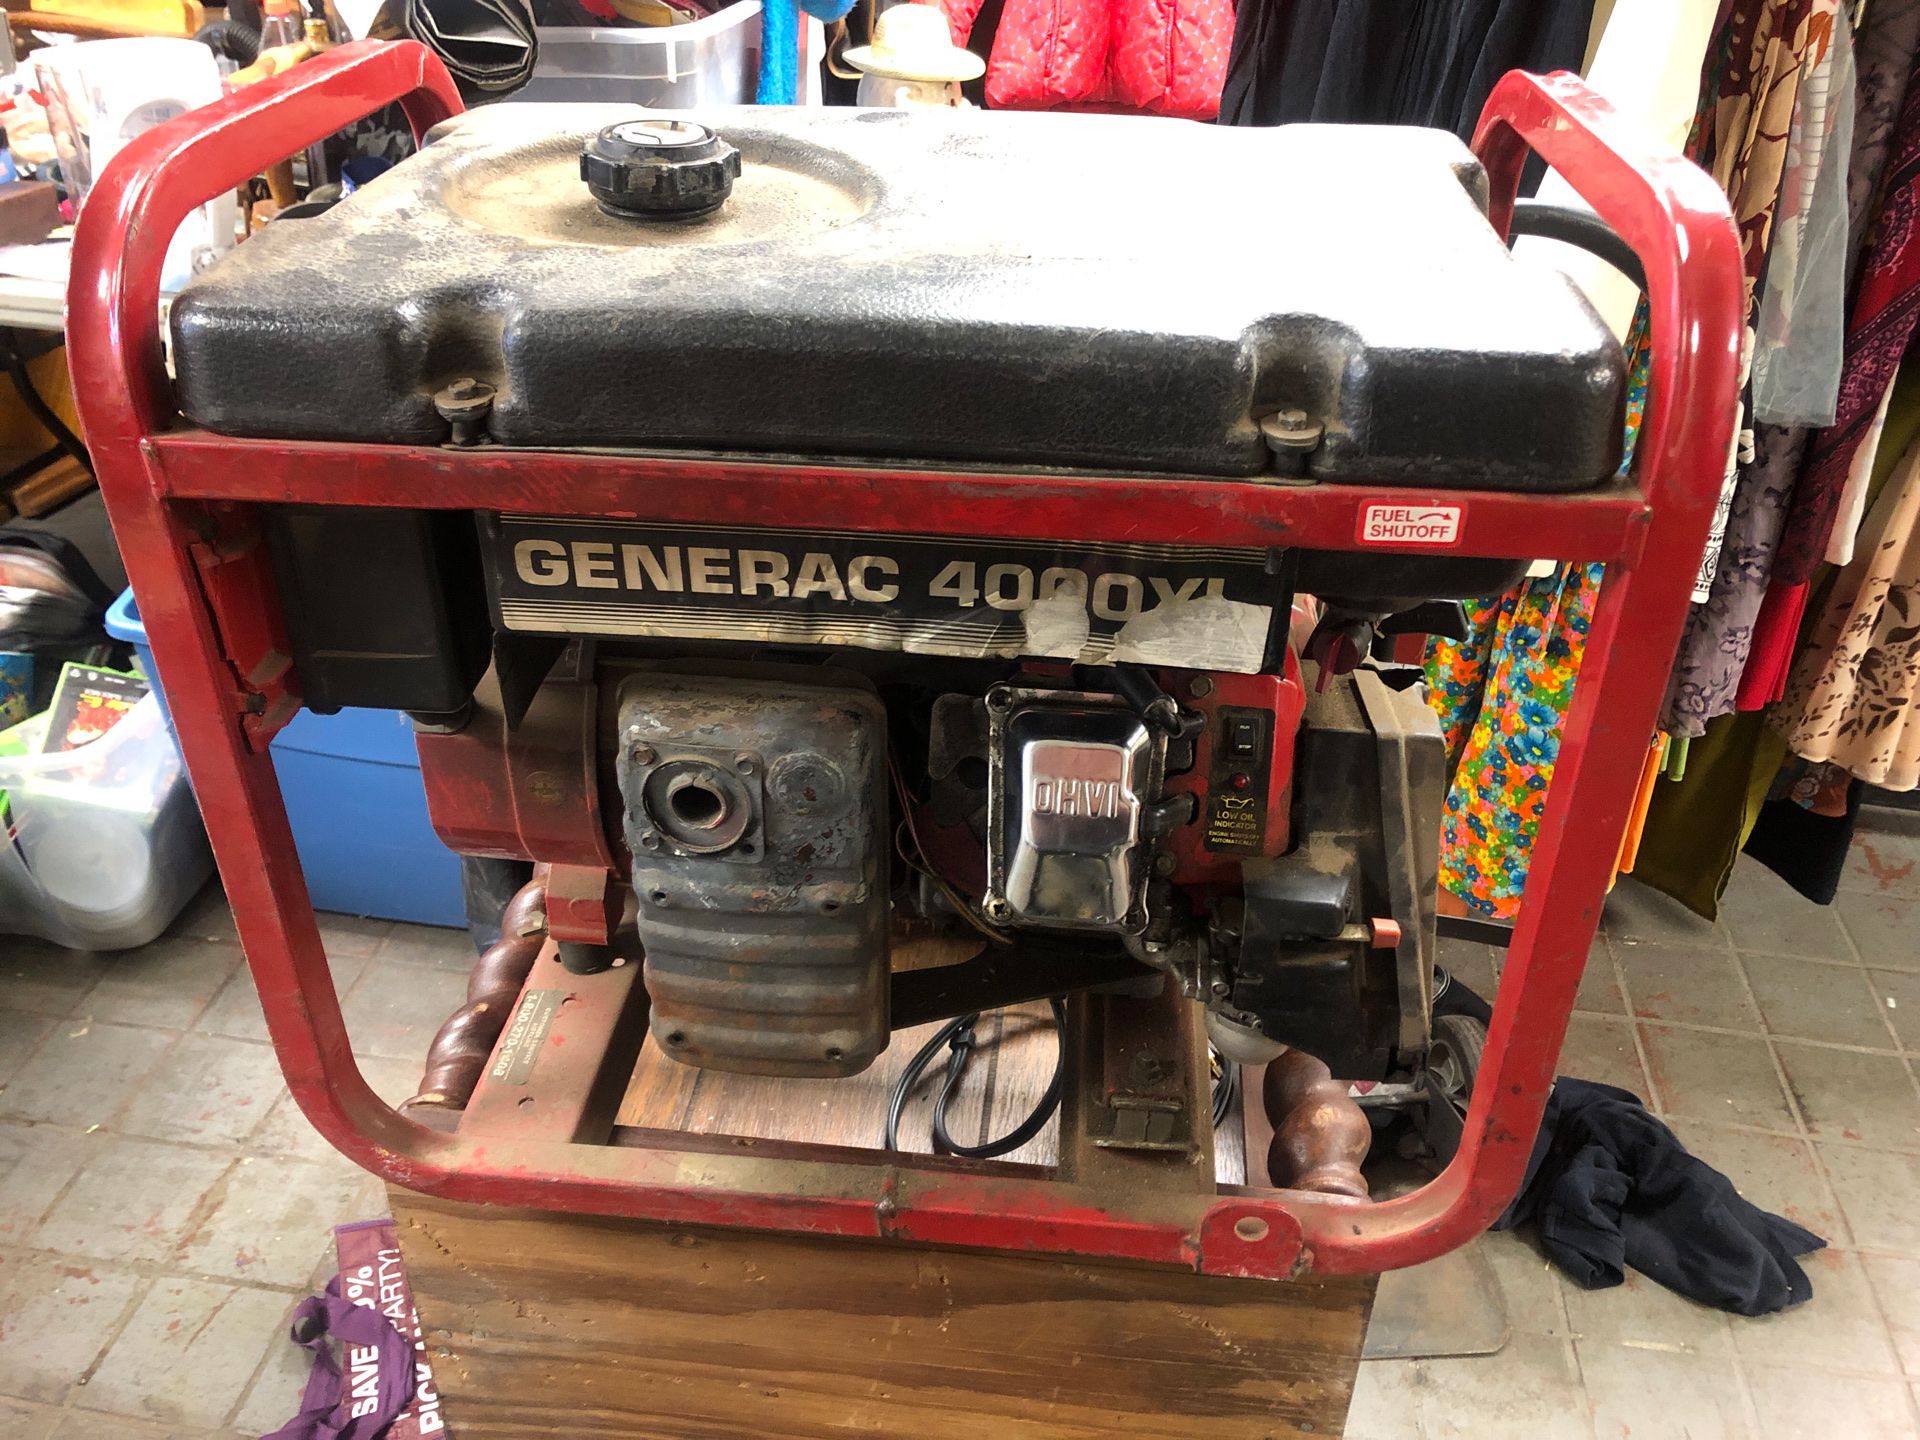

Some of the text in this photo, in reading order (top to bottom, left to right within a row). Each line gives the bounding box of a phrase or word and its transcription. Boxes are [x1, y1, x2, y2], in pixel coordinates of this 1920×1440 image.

[1372, 509, 1415, 522] FUEL
[1370, 524, 1450, 538] SHUTOFF
[513, 539, 900, 603] GENERAC
[1032, 777, 1120, 819] OHVI
[1216, 810, 1256, 822] LOW OIL
[1214, 820, 1257, 831] INDICATOR
[351, 1345, 379, 1419] SAVE
